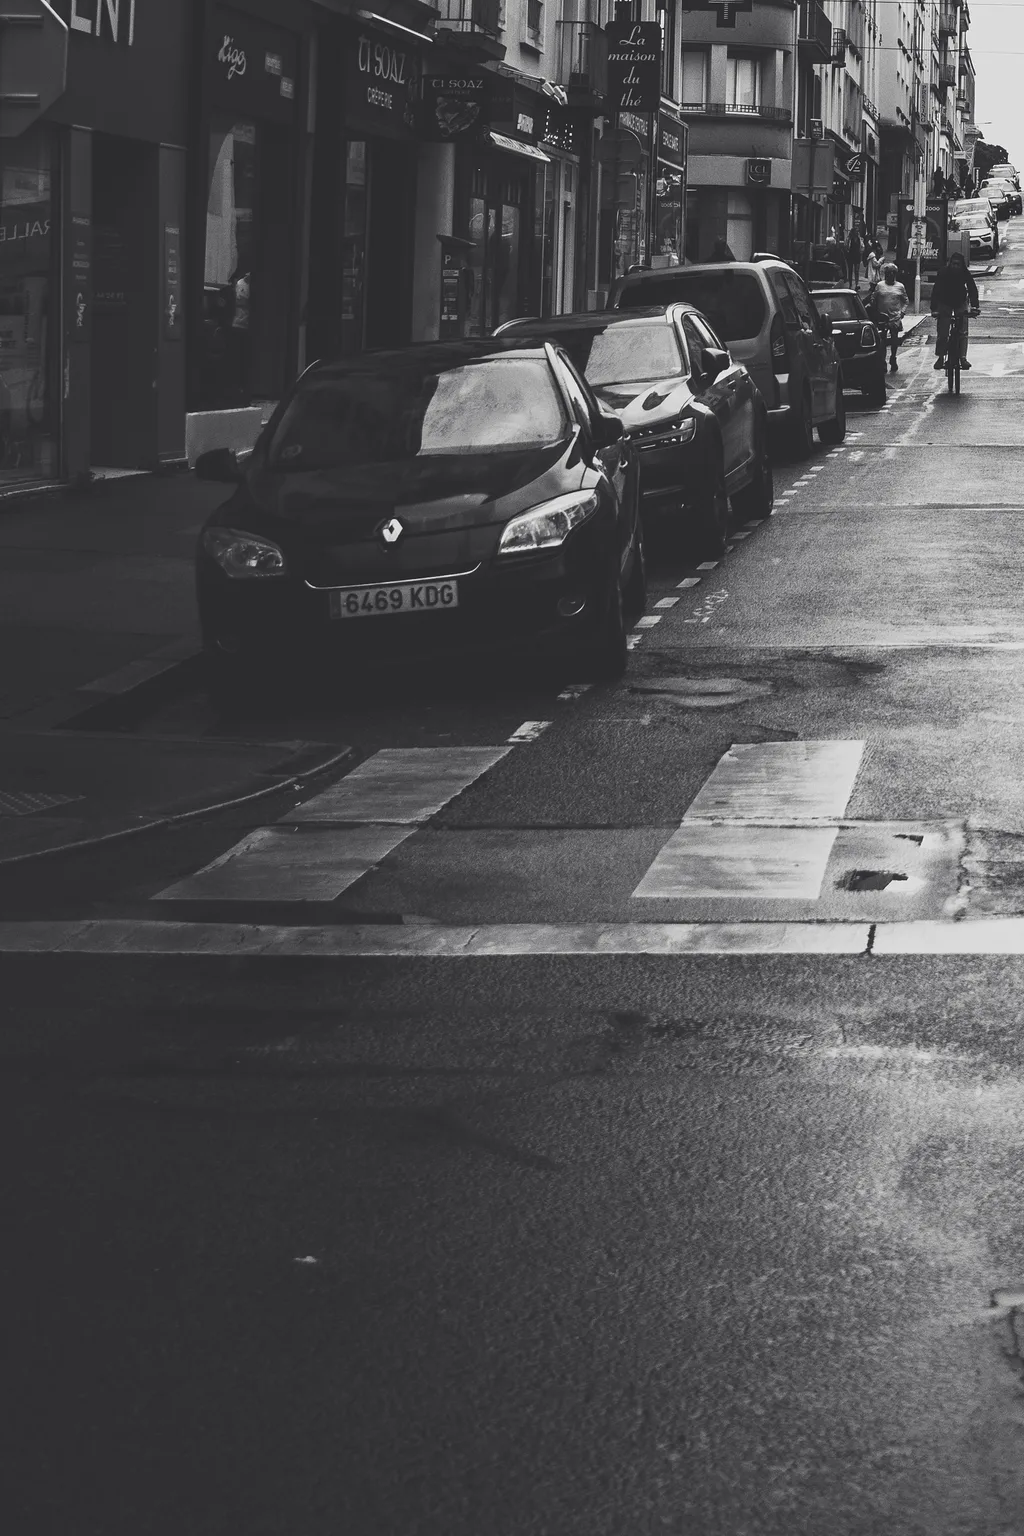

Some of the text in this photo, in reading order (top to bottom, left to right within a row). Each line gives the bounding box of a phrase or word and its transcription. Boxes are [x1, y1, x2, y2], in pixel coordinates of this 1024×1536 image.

[619, 25, 646, 46] La
[374, 43, 406, 85] SOAZ
[607, 49, 657, 62] maison
[448, 79, 484, 89] SOAZ
[622, 66, 641, 85] du
[620, 88, 642, 107] thé
[444, 254, 452, 265] P
[345, 584, 454, 614] 6469 KDG
